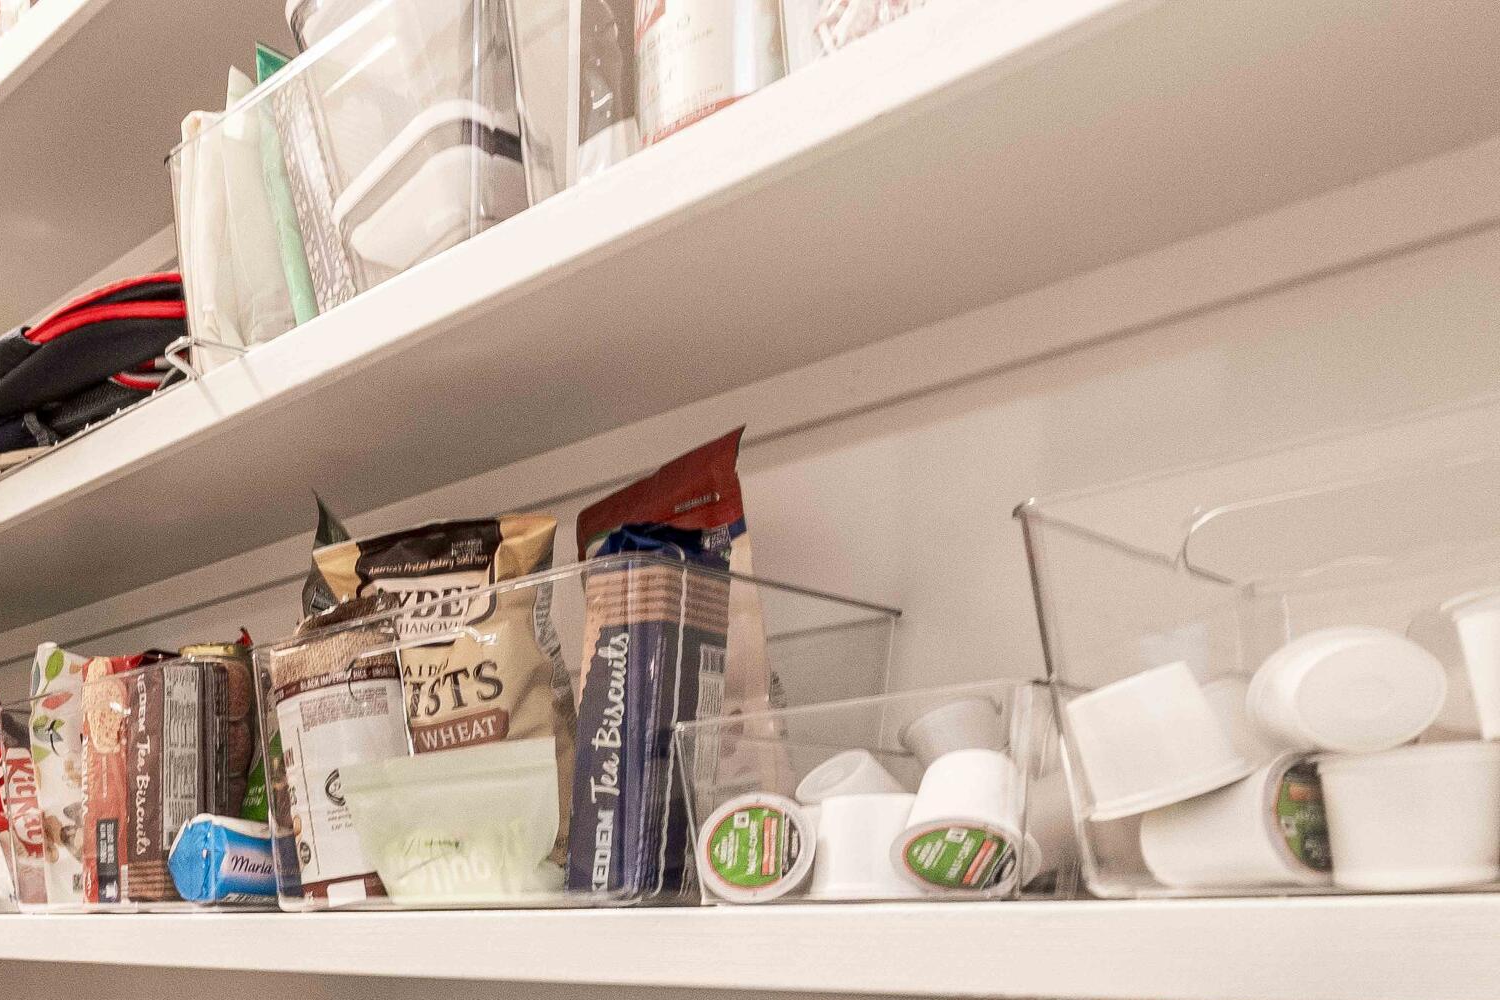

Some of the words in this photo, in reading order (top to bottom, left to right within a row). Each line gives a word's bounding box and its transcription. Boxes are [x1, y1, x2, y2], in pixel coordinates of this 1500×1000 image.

[404, 661, 503, 718] ISTS
[591, 632, 630, 750] Biscuits
[137, 735, 150, 772] Tea
[420, 716, 498, 750] WHEAT
[591, 753, 620, 804] Tea
[136, 775, 150, 855] Biscuits
[231, 855, 273, 875] Maria
